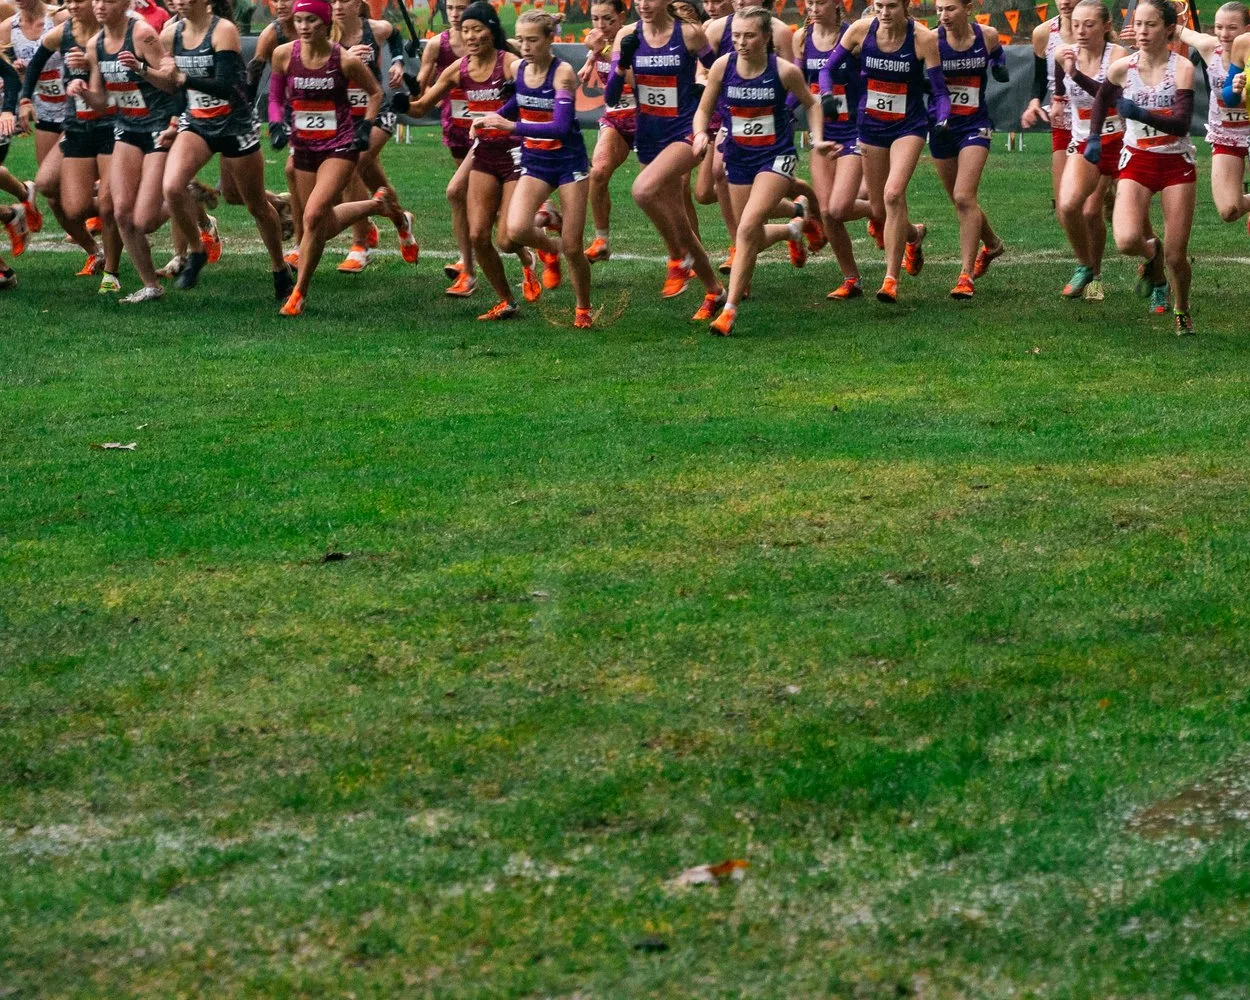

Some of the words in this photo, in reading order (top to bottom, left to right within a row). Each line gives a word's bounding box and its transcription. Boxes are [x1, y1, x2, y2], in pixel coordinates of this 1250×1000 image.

[636, 55, 681, 67] HINESBURG
[866, 56, 910, 72] HINESBURG
[942, 57, 986, 70] HINESBURG
[294, 77, 335, 90] TRABUCO
[648, 93, 666, 105] 83
[727, 86, 776, 99] HINESBURG
[951, 91, 969, 104] 79
[876, 98, 893, 111] 81
[306, 116, 325, 129] 23
[743, 123, 763, 135] 82
